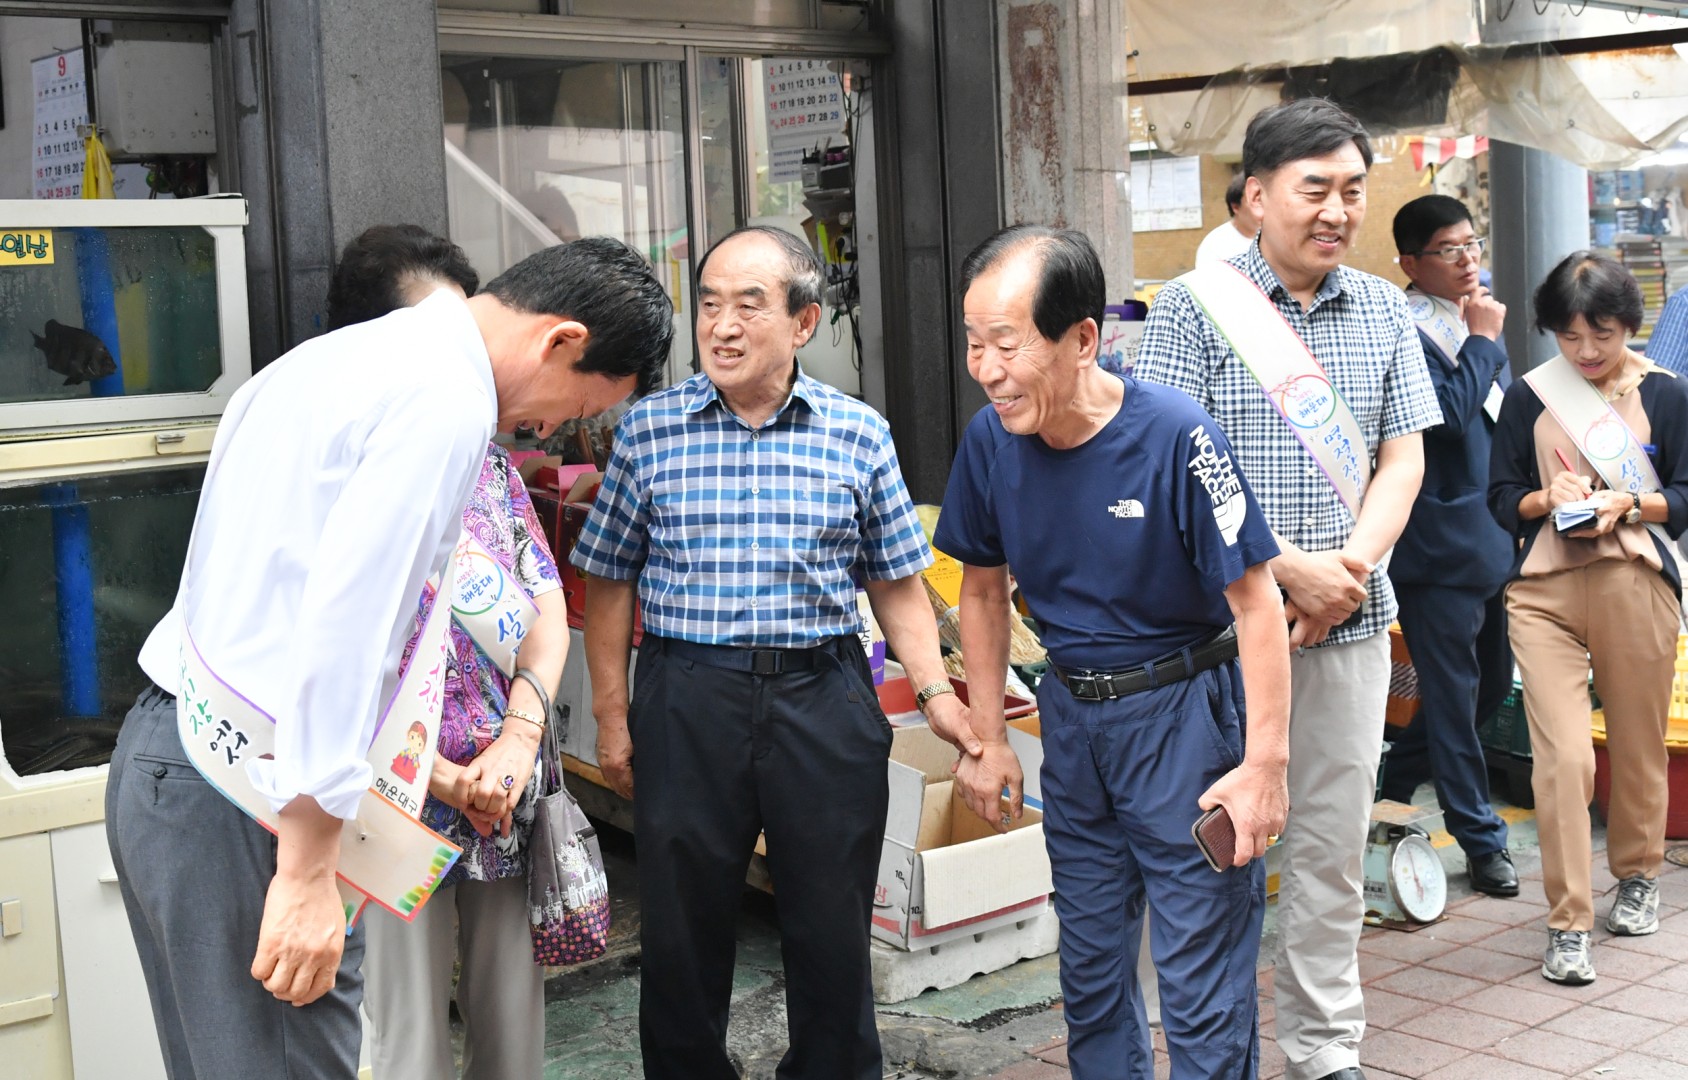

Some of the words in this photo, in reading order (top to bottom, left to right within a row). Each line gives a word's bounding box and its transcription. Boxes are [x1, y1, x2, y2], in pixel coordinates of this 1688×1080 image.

[57, 56, 67, 77] 9
[770, 67, 774, 75] 2
[780, 65, 783, 73] 3
[788, 64, 792, 72] 4
[807, 61, 813, 69] 6
[771, 84, 775, 92] 9
[779, 83, 785, 91] 10
[787, 81, 794, 90] 11
[796, 80, 804, 89] 12
[806, 78, 815, 87] 13
[817, 77, 826, 85] 14
[829, 75, 836, 84] 15
[770, 102, 777, 110] 16
[780, 100, 786, 109] 17
[788, 99, 795, 108] 18
[797, 97, 804, 106] 19
[807, 96, 816, 105] 20
[818, 95, 827, 103] 21
[829, 93, 838, 102] 22
[44, 123, 49, 134] 3
[53, 121, 59, 132] 4
[63, 120, 68, 130] 5
[71, 118, 75, 129] 6
[780, 118, 787, 126] 24
[789, 117, 795, 125] 25
[798, 115, 805, 124] 26
[807, 114, 816, 123] 27
[819, 113, 828, 121] 28
[830, 111, 839, 120] 29
[44, 145, 52, 156] 10
[53, 144, 61, 154] 11
[63, 142, 70, 153] 12
[71, 140, 78, 151] 13
[44, 167, 52, 177] 17
[54, 166, 62, 176] 18
[64, 164, 71, 175] 19
[72, 163, 79, 173] 20
[72, 185, 80, 196] 27
[1299, 395, 1328, 419] 해운대
[1188, 454, 1227, 509] FACE
[1219, 450, 1243, 496] THE
[461, 575, 494, 604] 해운대
[375, 777, 418, 813] 해운대구
